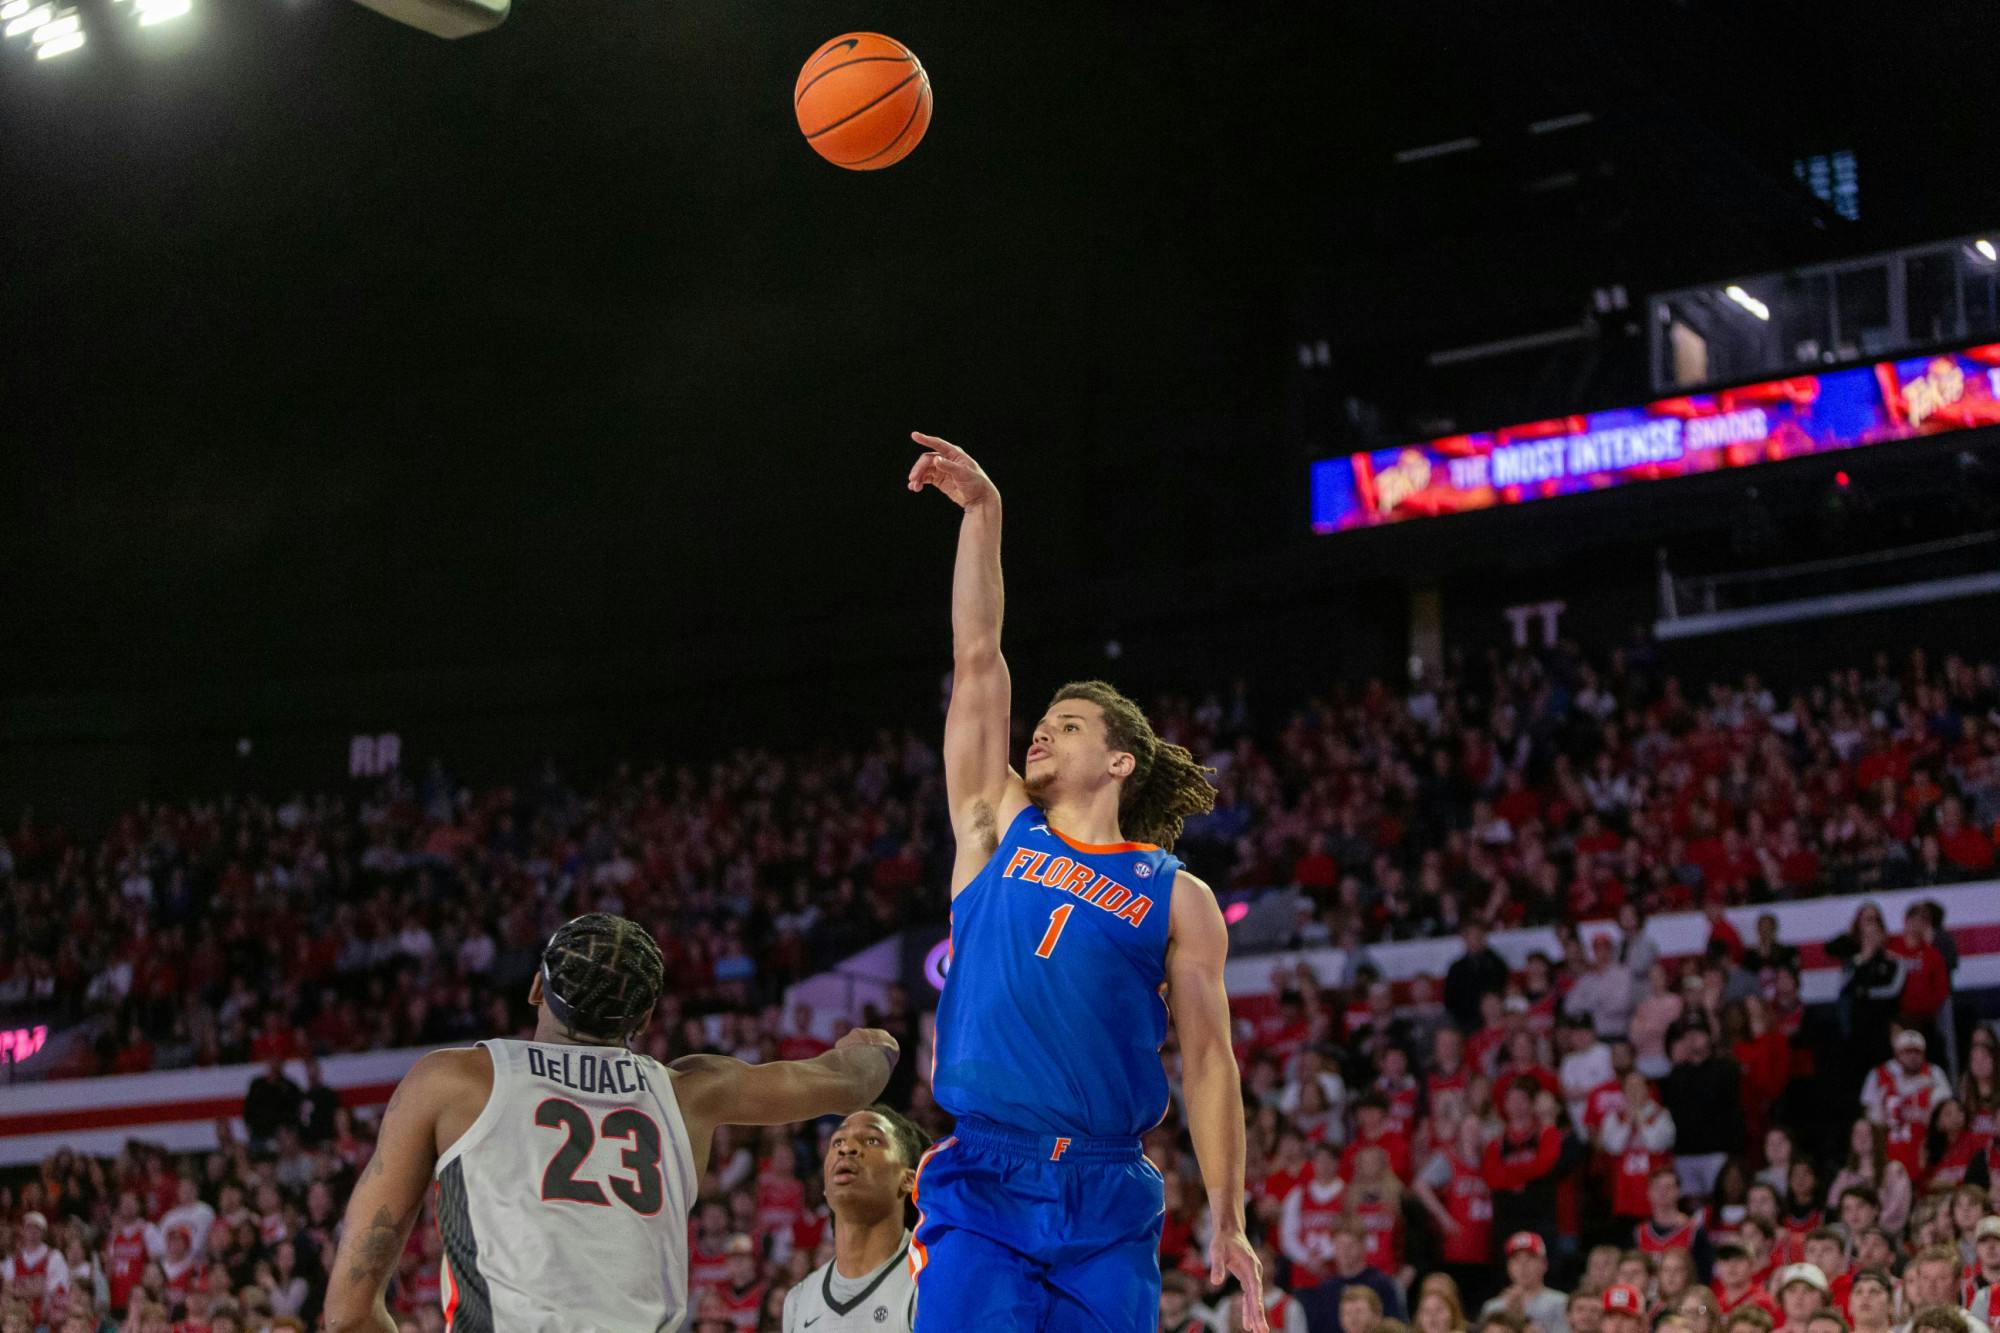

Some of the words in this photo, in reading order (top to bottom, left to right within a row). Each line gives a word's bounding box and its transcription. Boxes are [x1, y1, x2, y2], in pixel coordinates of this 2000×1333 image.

[1491, 437, 1565, 488] MOST
[1566, 417, 1684, 476] INTENSE
[1003, 846, 1154, 928] FLORIDA
[1035, 903, 1075, 959] 1
[535, 1097, 663, 1216] 23
[1050, 1137, 1071, 1161] F
